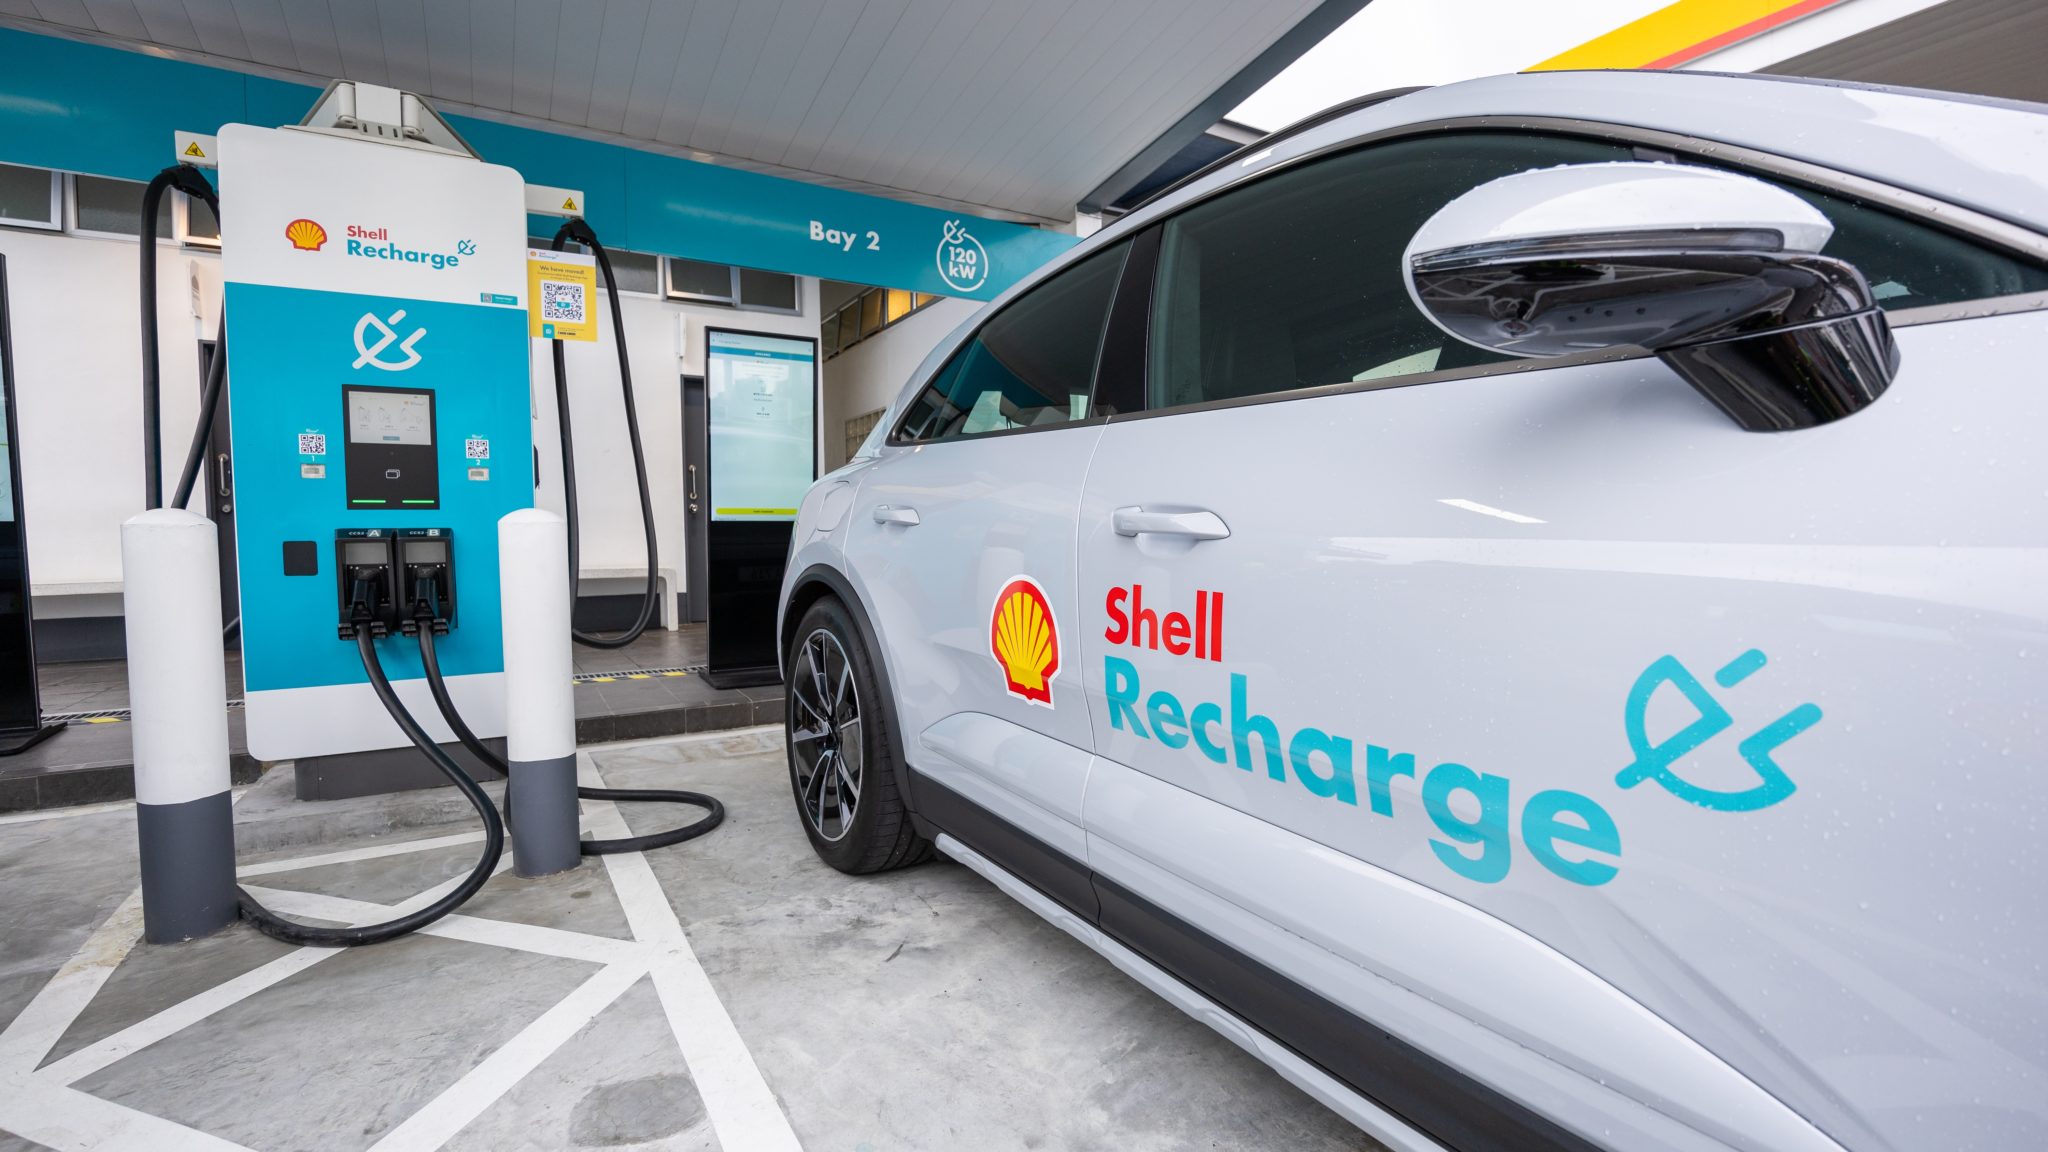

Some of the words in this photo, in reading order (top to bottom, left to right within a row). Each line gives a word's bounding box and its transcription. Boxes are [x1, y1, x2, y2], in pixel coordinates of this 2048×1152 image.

[347, 225, 388, 241] Shell
[809, 220, 857, 252] Bay
[866, 230, 880, 251] 2
[347, 239, 459, 270] Recharge
[949, 246, 977, 265] 120
[949, 261, 976, 280] kW
[1104, 584, 1224, 662] Shell
[1104, 655, 1622, 886] Recharge
